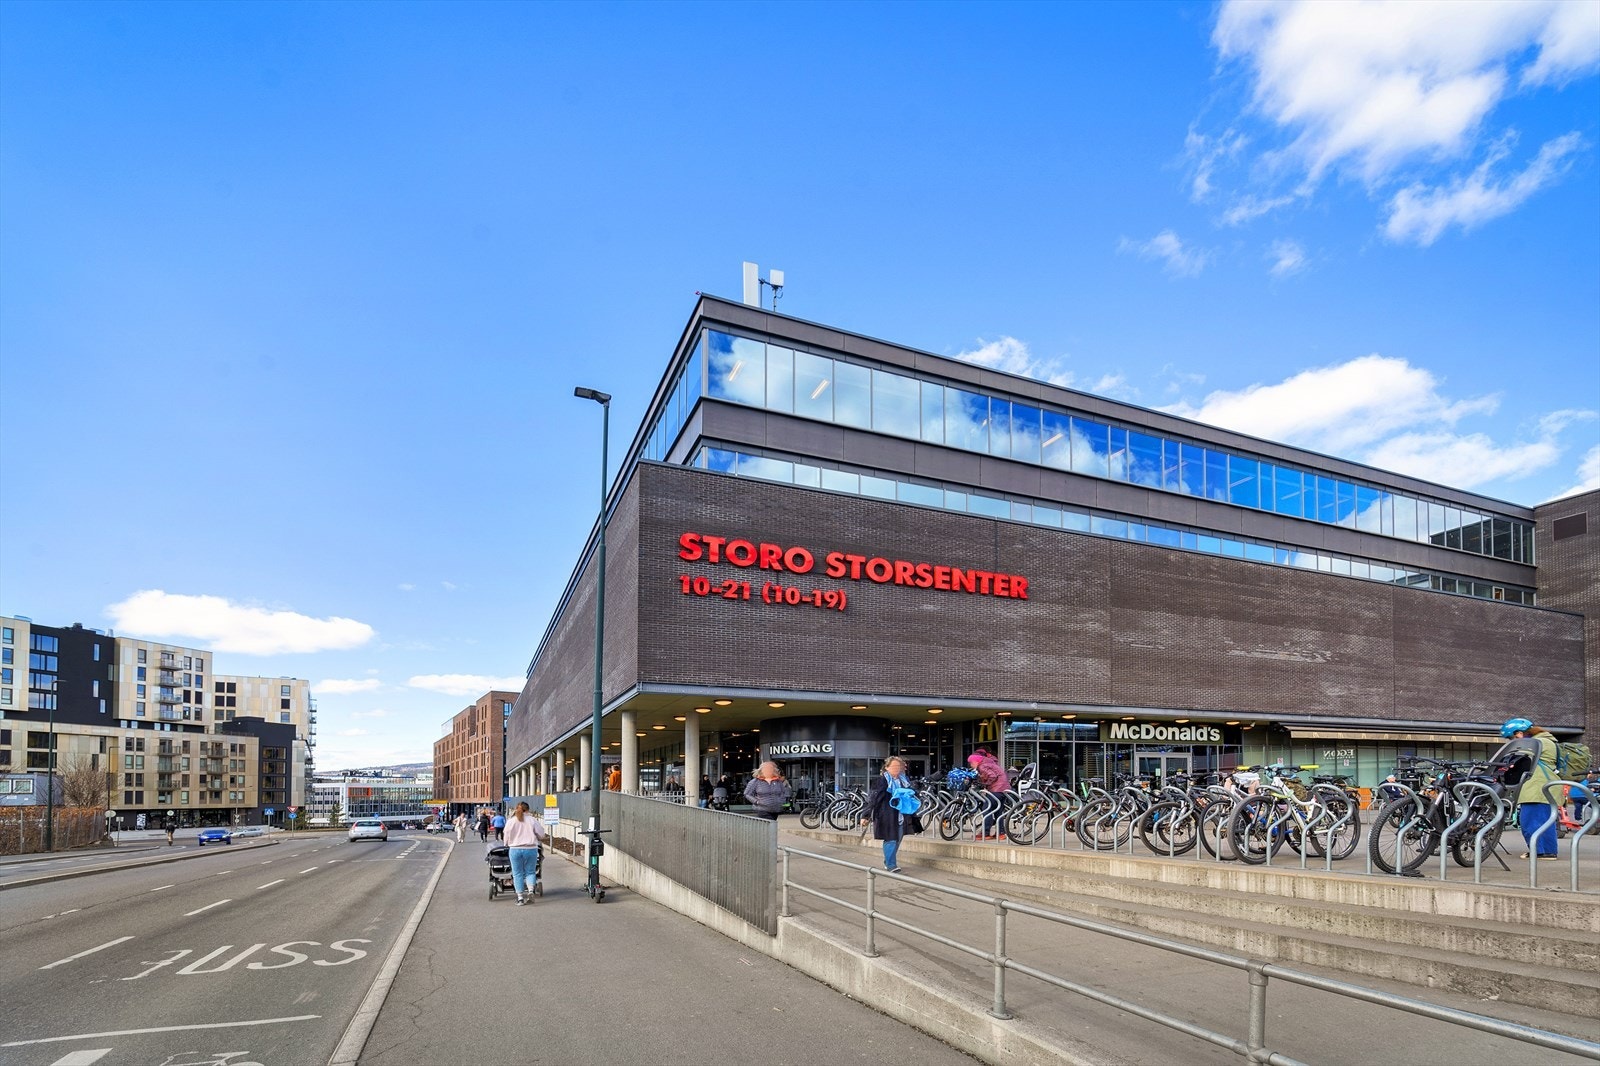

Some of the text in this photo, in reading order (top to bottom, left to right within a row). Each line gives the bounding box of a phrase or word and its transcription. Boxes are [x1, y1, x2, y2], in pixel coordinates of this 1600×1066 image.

[679, 532, 1029, 600] STORO STORSENTER
[679, 575, 848, 611] 10-21 (10-19)
[1110, 722, 1221, 742] McDonald's
[769, 743, 833, 755] INNGANG
